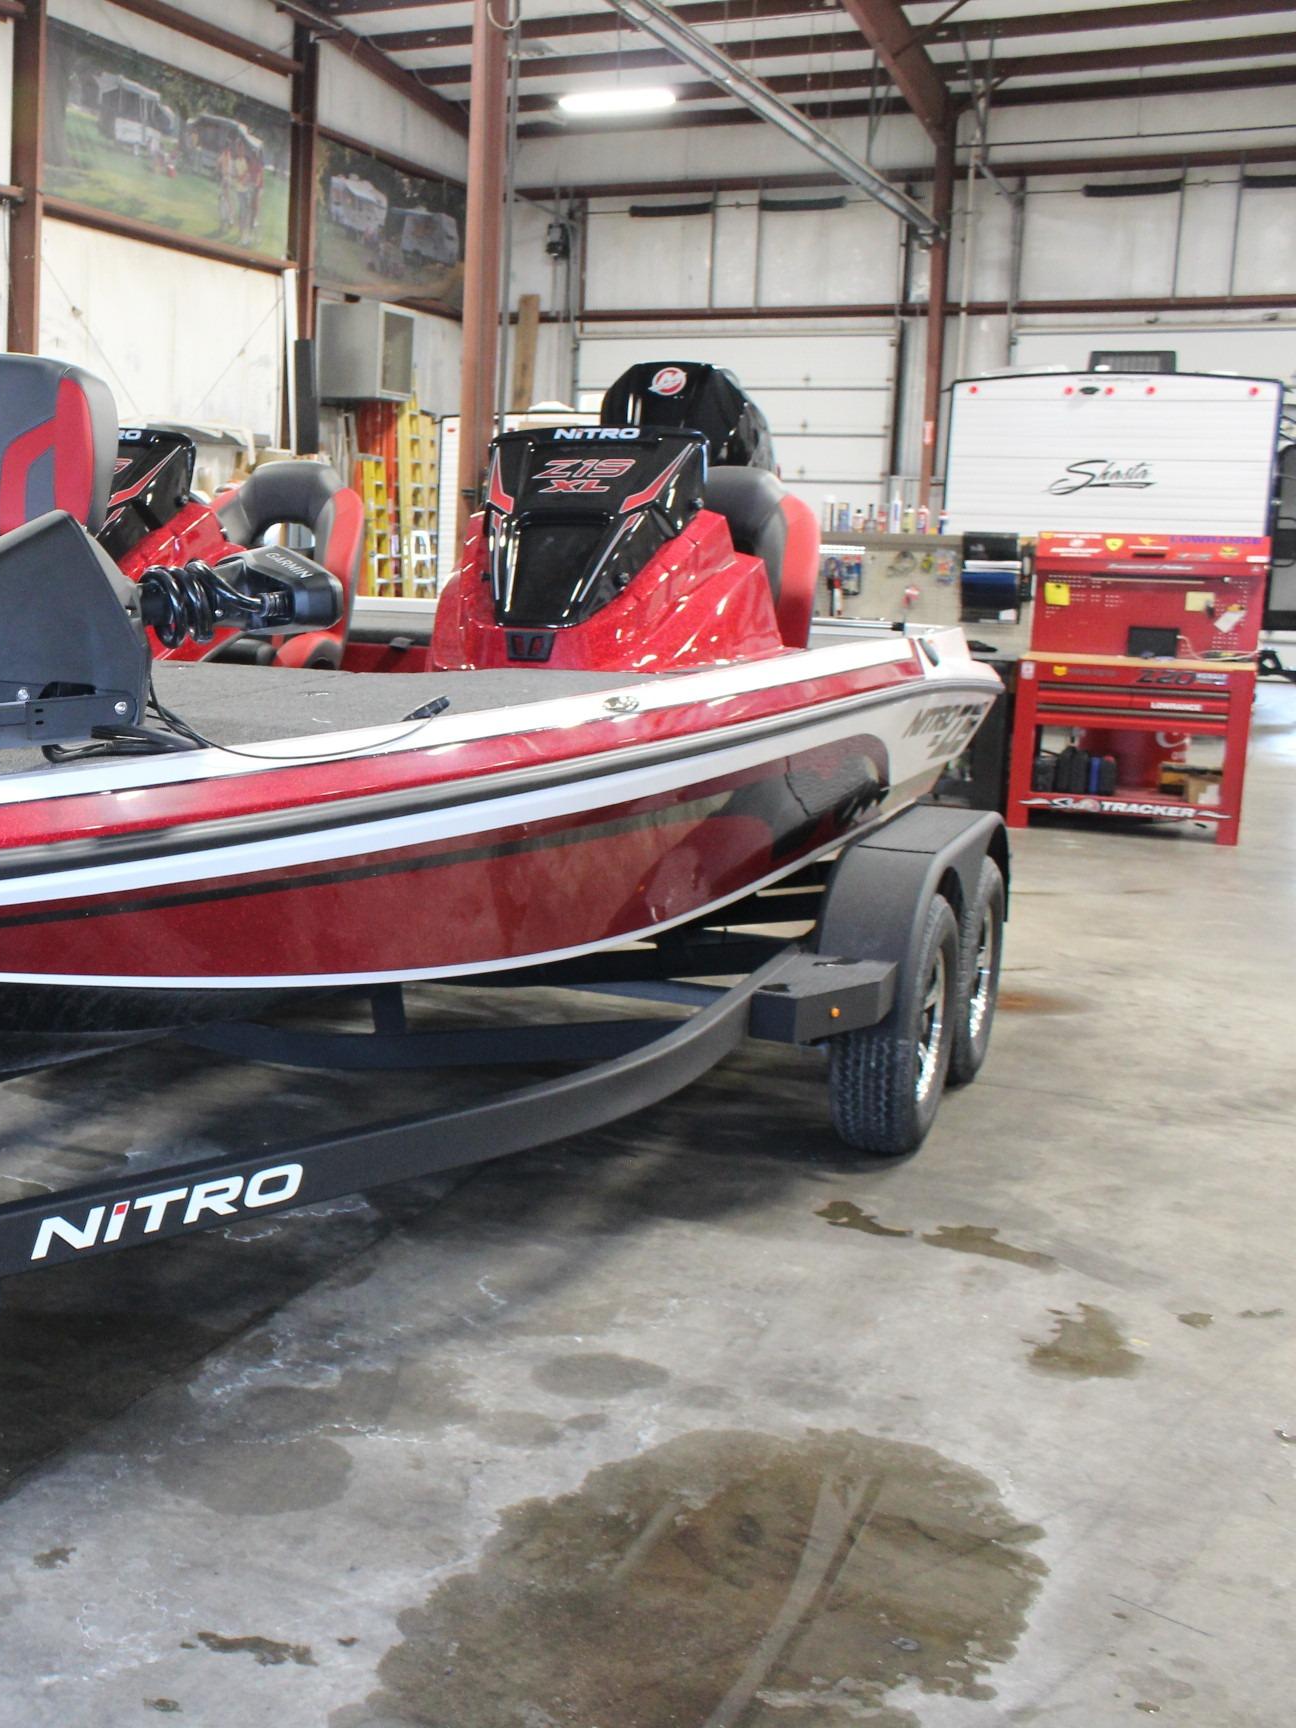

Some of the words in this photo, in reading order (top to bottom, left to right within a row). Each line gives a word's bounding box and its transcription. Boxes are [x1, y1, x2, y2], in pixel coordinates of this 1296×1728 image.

[553, 427, 641, 440] NITRO
[538, 479, 611, 493] XL
[1047, 459, 1154, 495] Shasta
[265, 552, 312, 579] GARMIN
[1101, 800, 1199, 818] TRACKER
[30, 1163, 304, 1261] NITRO
